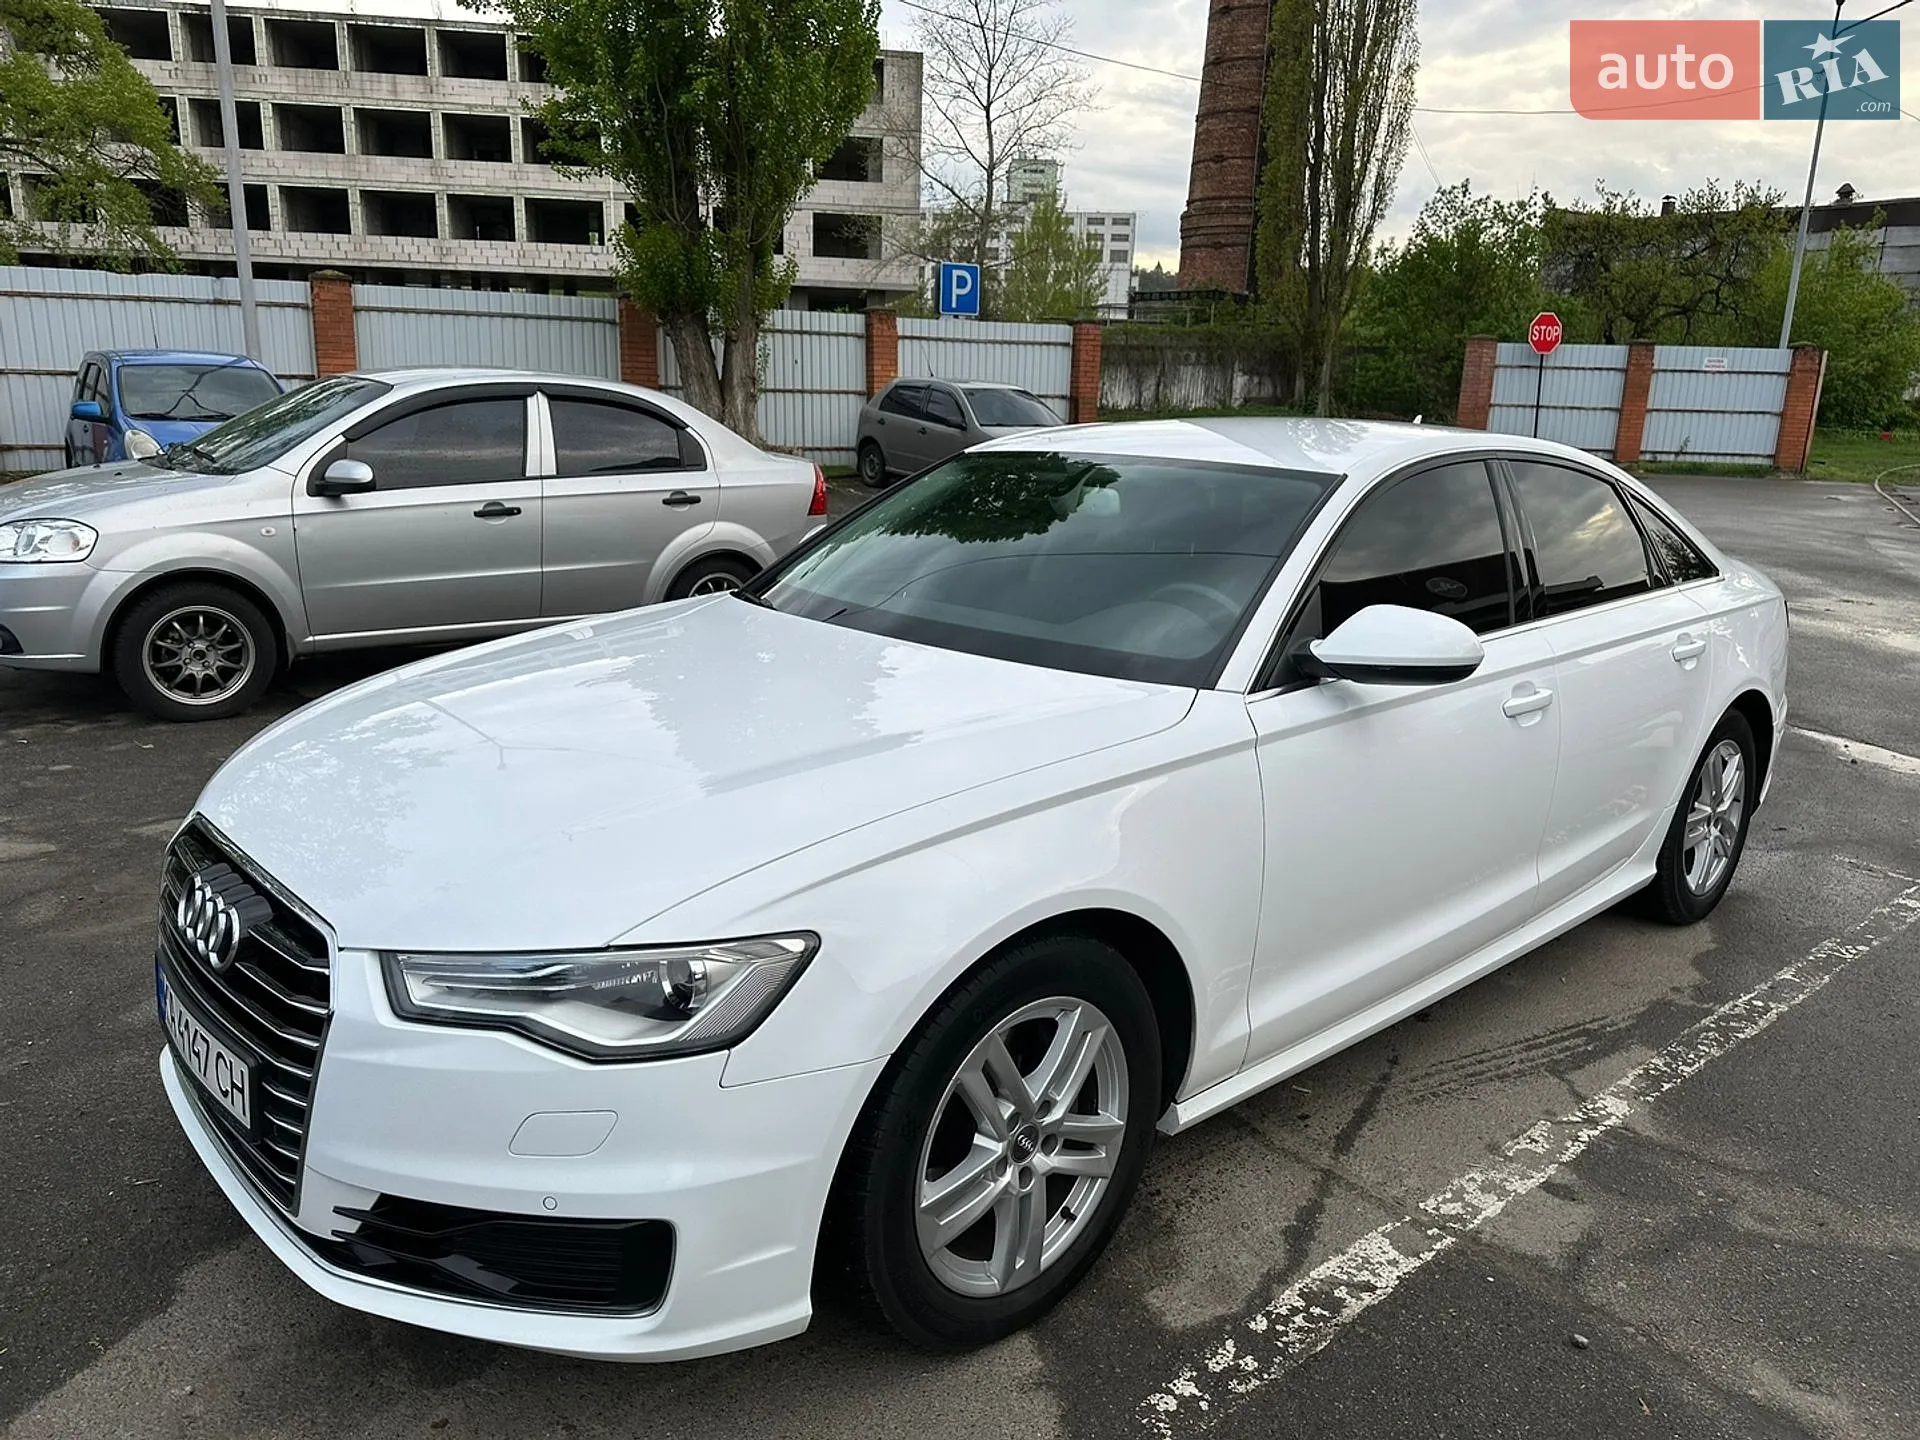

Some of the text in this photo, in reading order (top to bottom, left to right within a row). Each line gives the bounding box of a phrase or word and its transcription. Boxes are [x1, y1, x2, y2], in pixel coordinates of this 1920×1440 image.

[951, 269, 972, 309] P
[1532, 325, 1560, 342] STOP
[178, 1008, 210, 1078] 4147
[215, 1050, 247, 1117] CH
